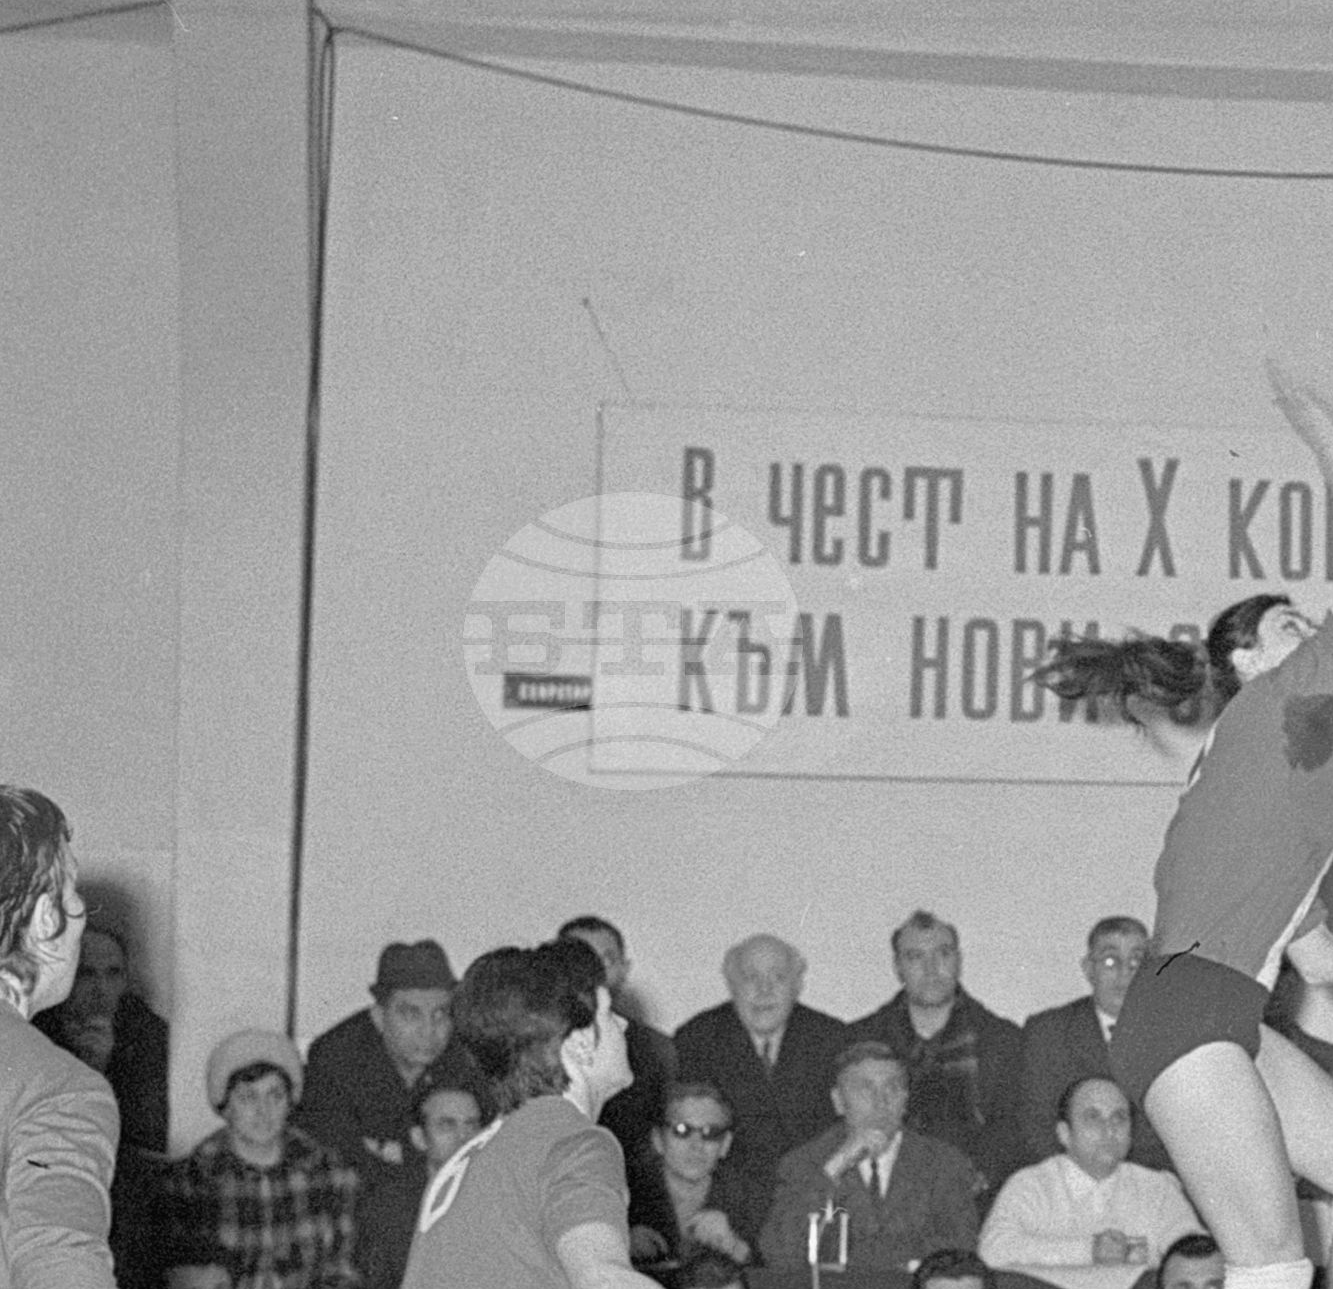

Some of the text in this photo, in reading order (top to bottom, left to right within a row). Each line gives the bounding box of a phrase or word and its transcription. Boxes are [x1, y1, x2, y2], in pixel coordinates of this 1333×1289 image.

[681, 446, 716, 562] В
[1014, 470, 1101, 575] НА
[1135, 457, 1180, 577] Х
[677, 608, 850, 717] КЪМ
